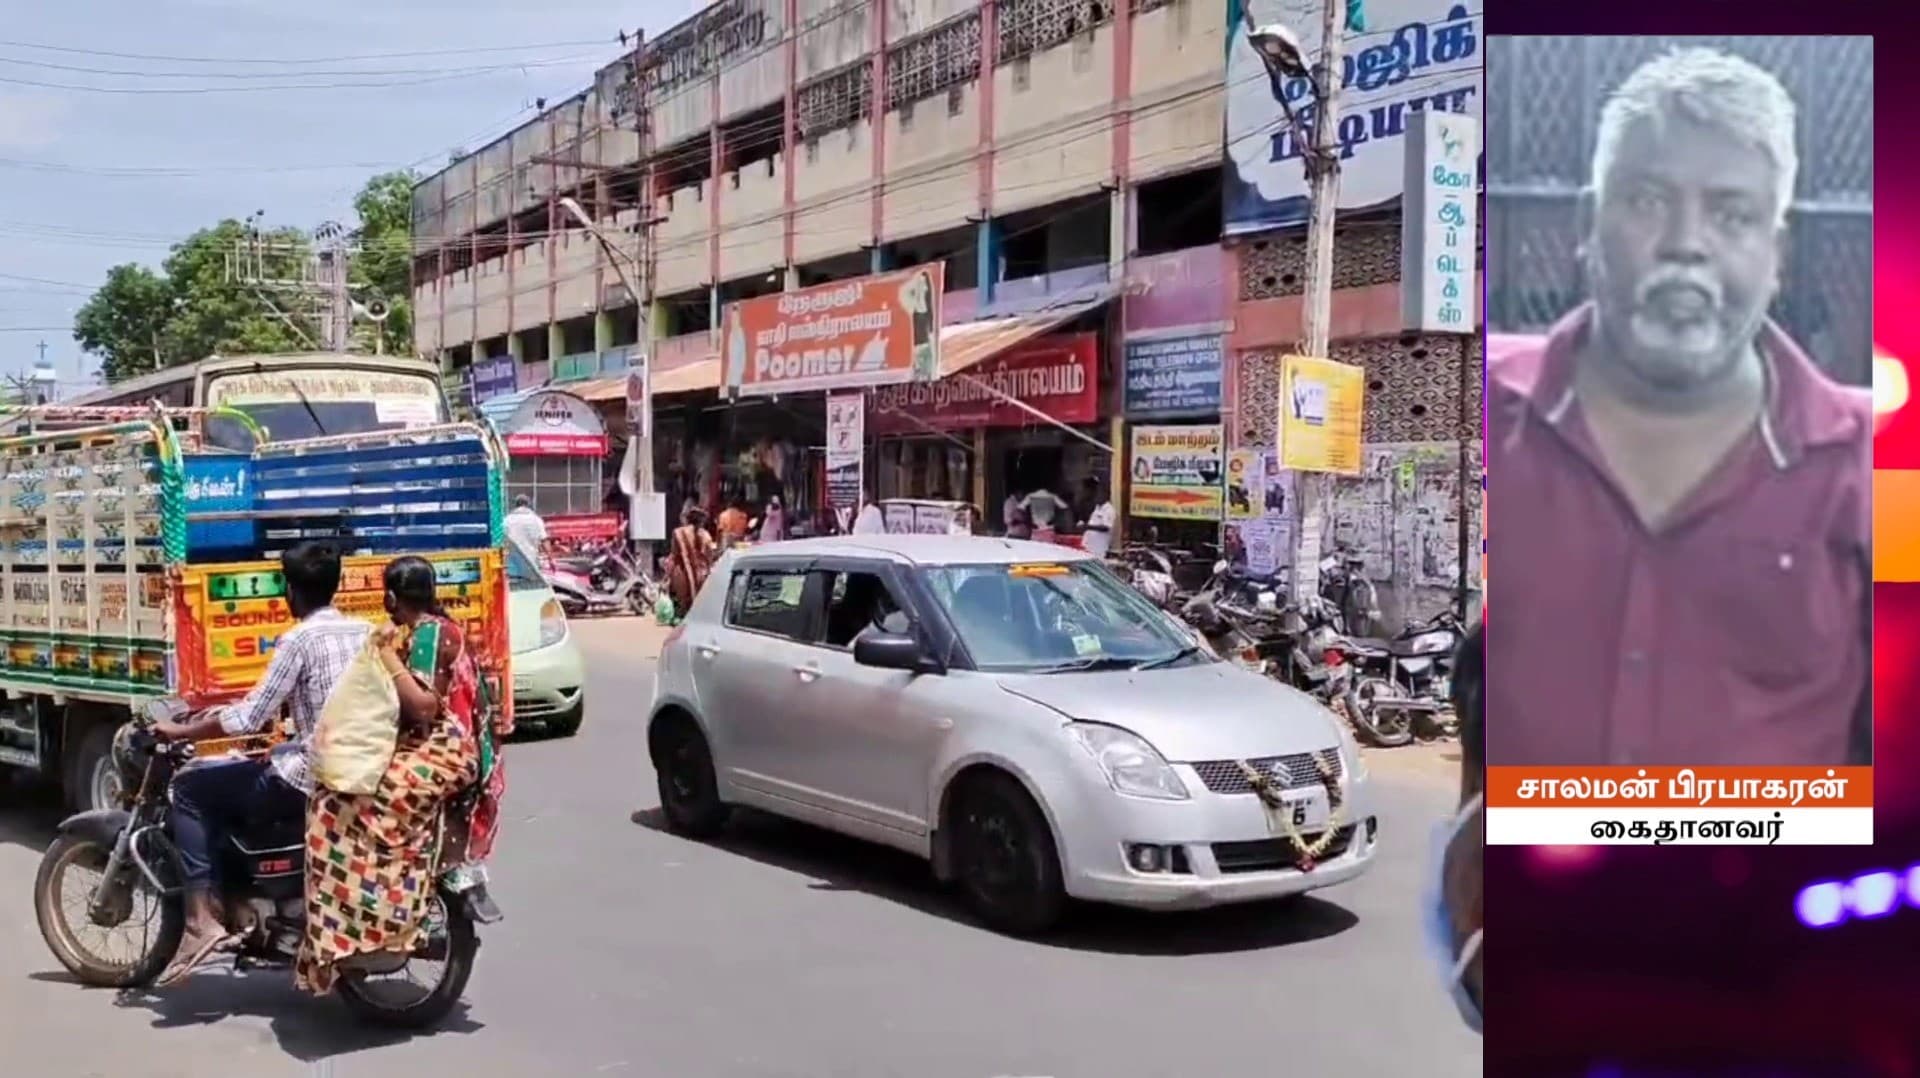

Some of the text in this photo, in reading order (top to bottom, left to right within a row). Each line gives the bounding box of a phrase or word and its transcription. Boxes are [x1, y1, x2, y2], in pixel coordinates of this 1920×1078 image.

[1283, 5, 1476, 103] ஜிக்
[755, 344, 856, 382] Poomer
[213, 610, 288, 628] SOUND
[214, 635, 281, 657] ASH
